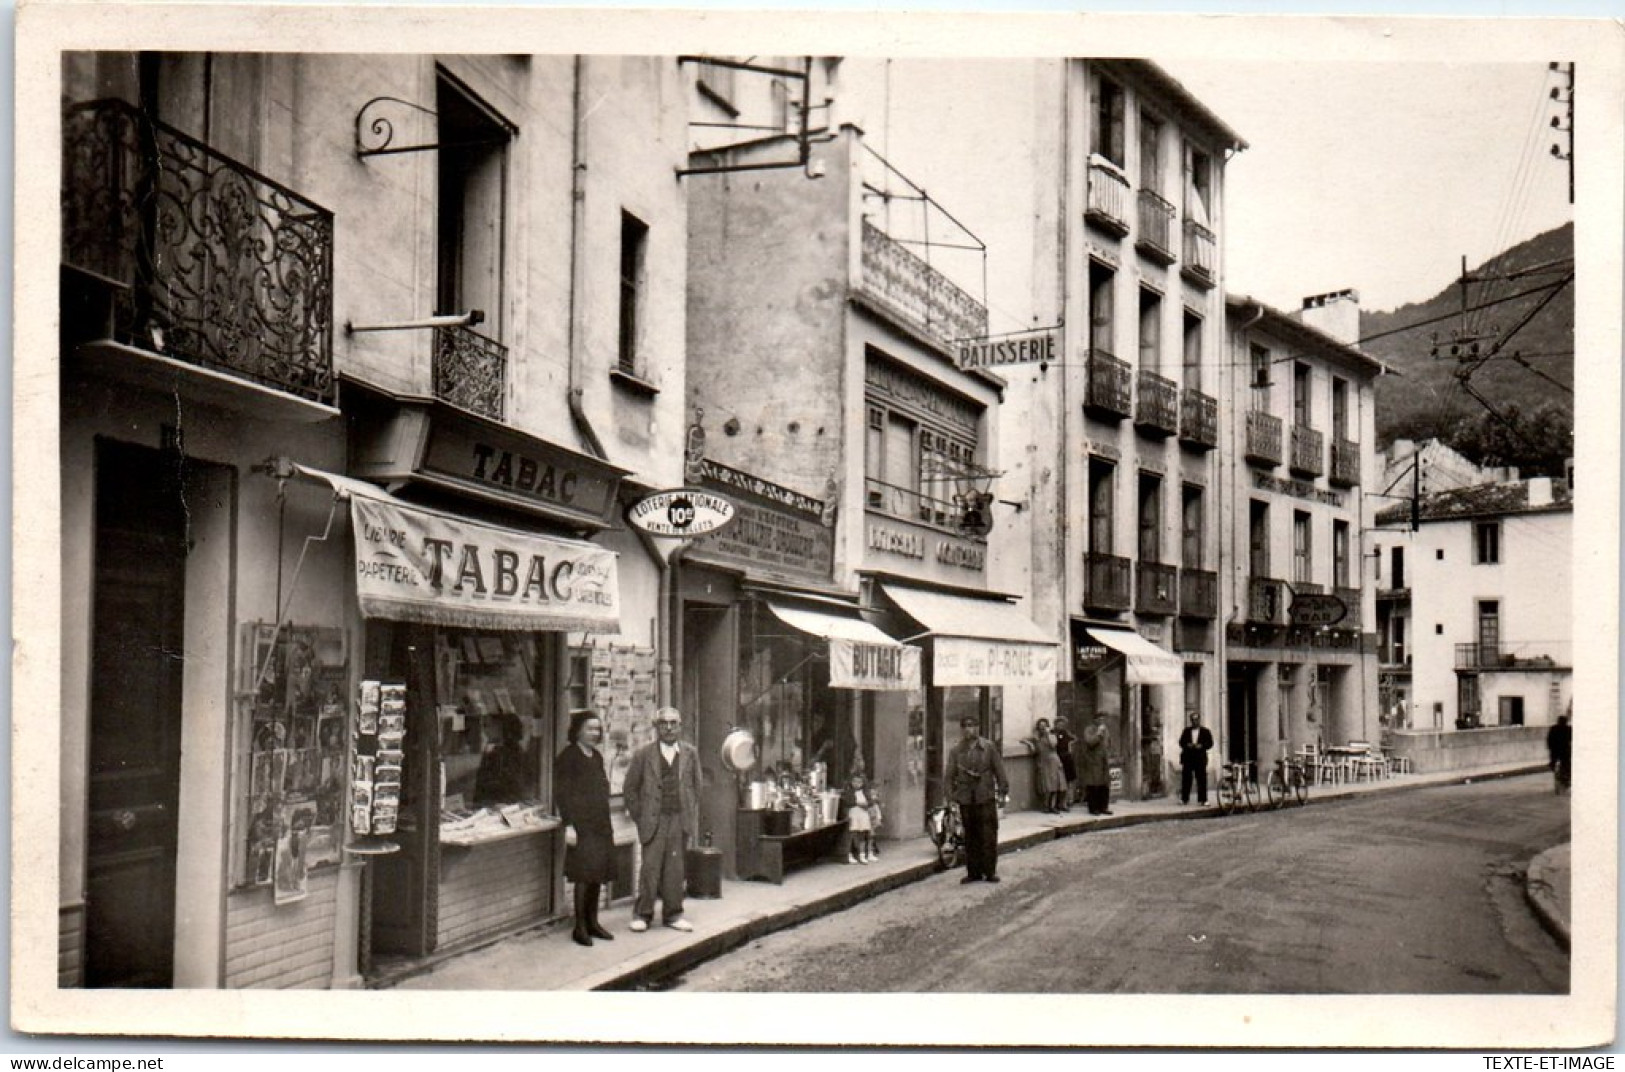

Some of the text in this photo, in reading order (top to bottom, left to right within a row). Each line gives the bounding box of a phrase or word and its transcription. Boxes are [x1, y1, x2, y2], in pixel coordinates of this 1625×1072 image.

[959, 337, 1055, 369] PATISSERIE
[473, 443, 577, 503] TABAC
[424, 537, 575, 602] TABAC
